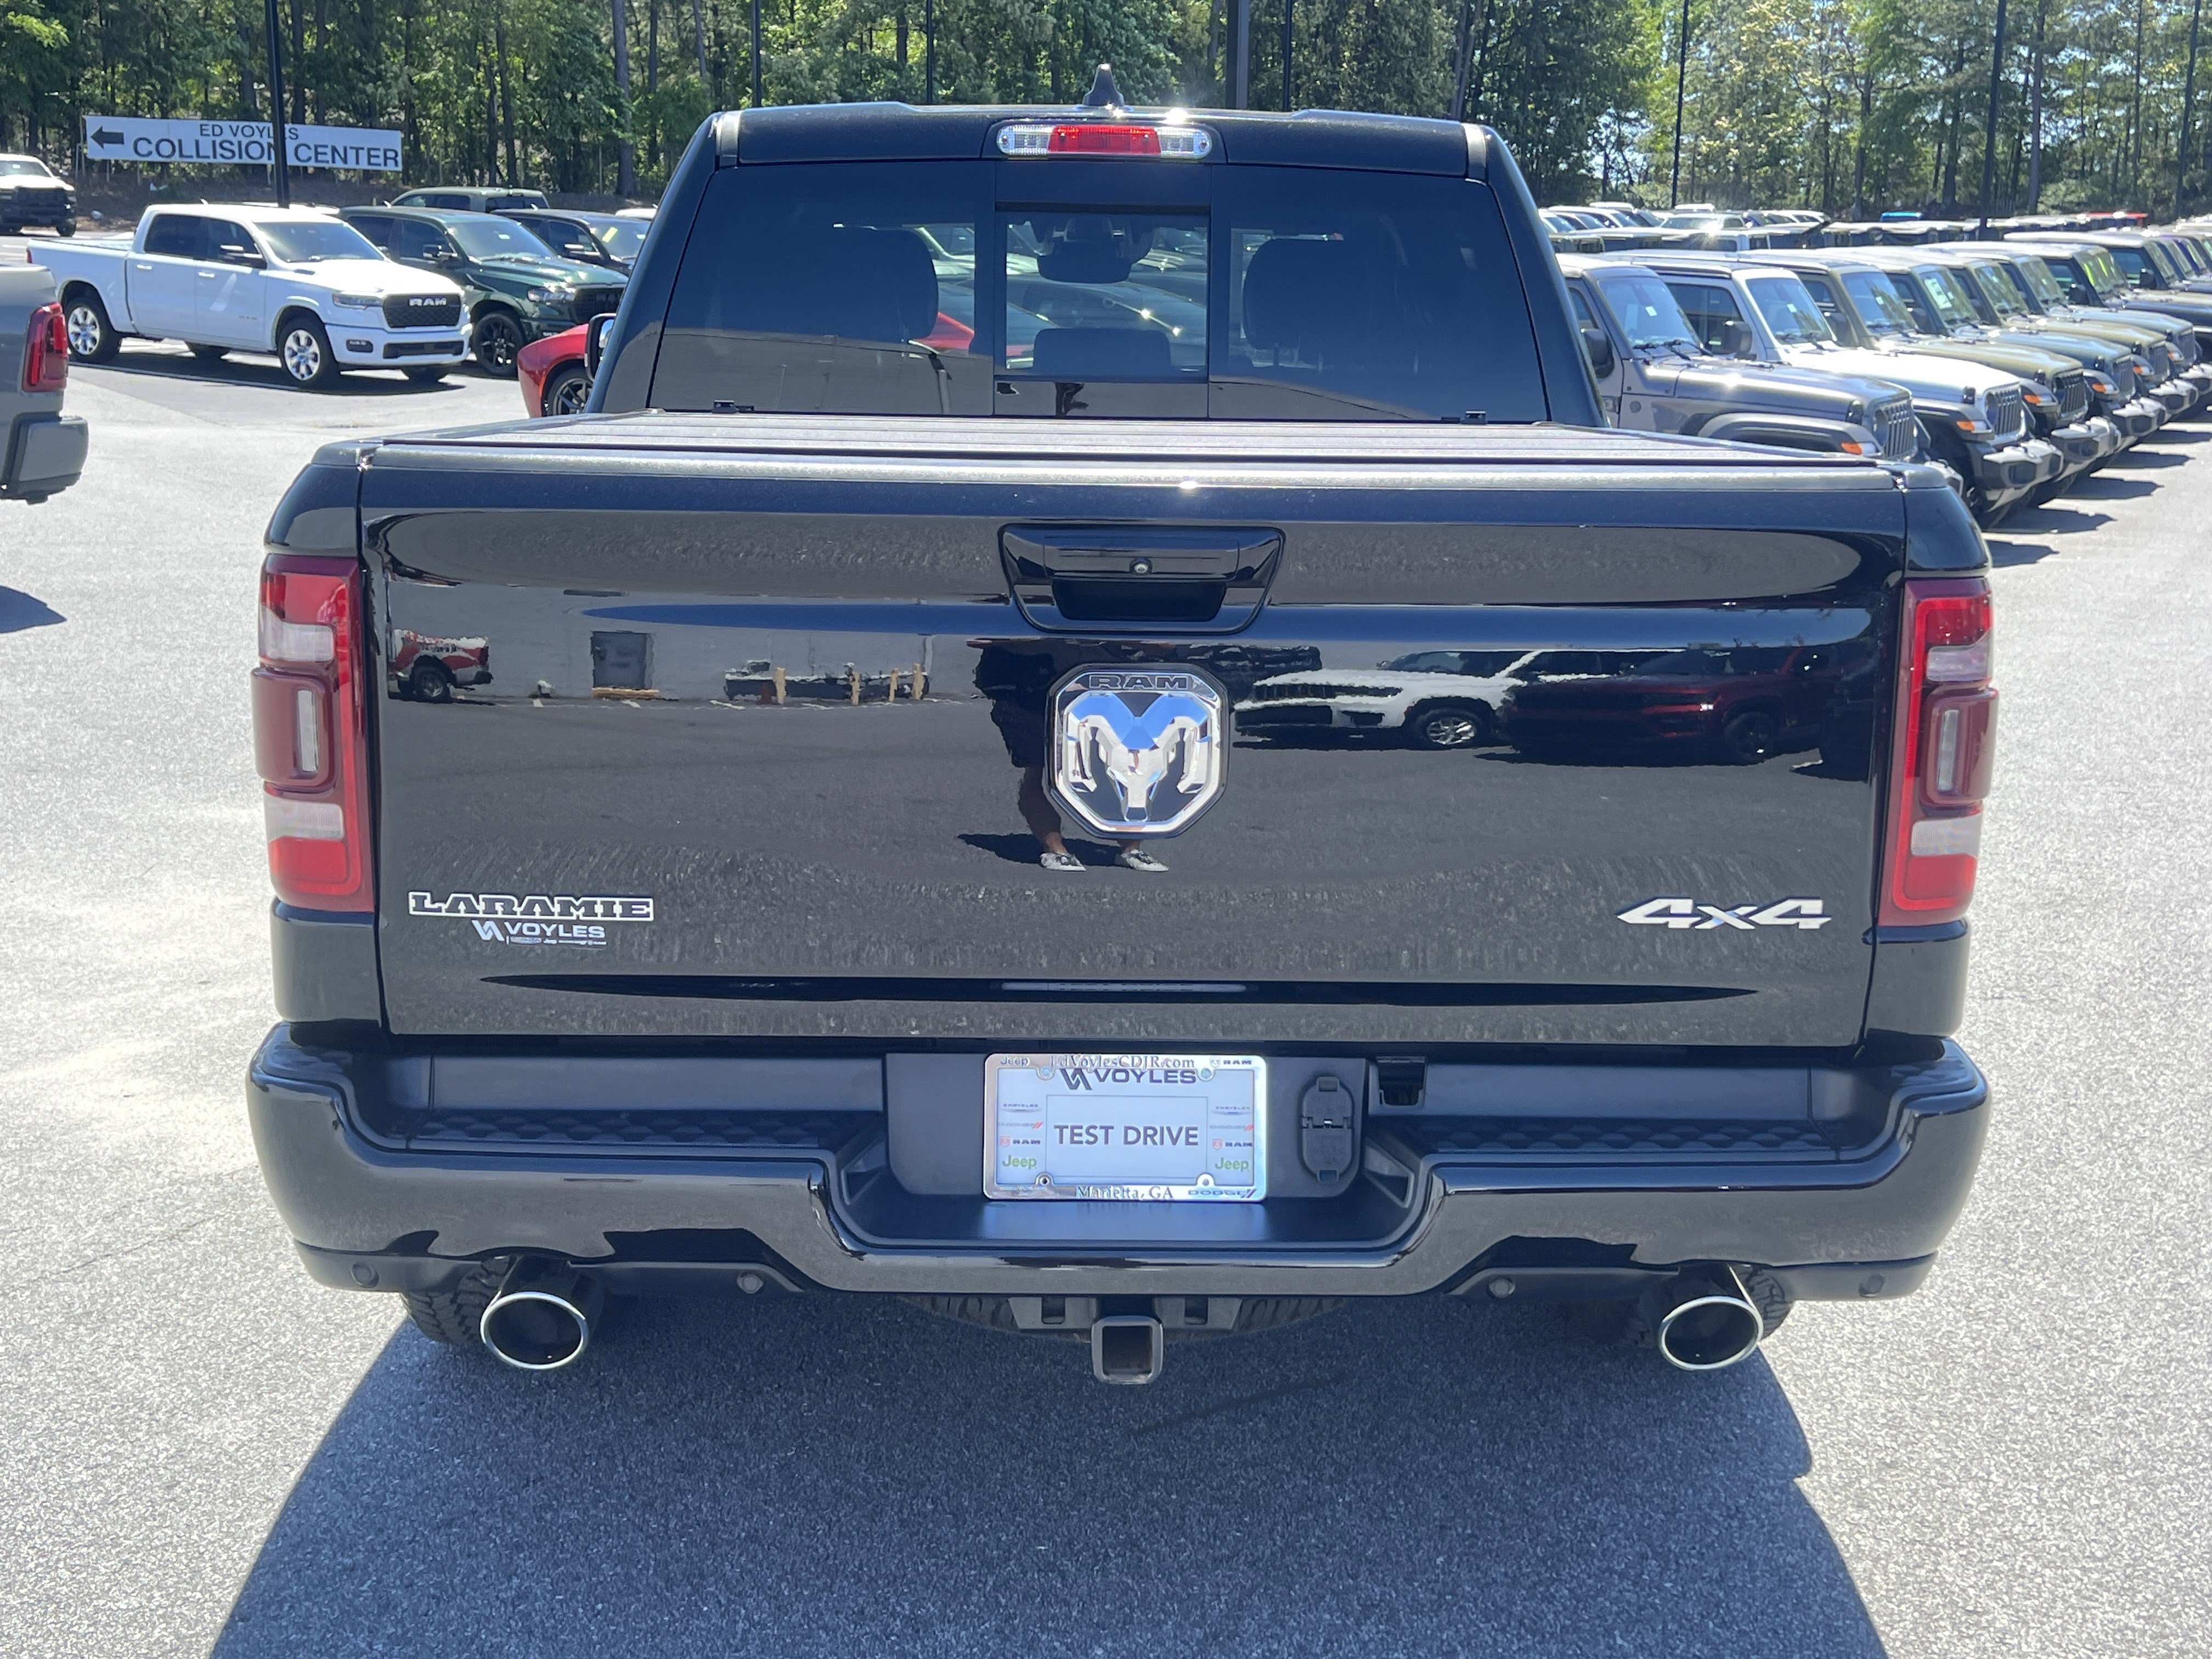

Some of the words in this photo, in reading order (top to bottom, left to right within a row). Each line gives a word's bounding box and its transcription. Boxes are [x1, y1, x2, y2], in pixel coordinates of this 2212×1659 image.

[200, 124, 223, 137] ED
[228, 125, 299, 140] VOYLS
[294, 143, 399, 167] CENTER
[409, 298, 447, 306] RAM
[1088, 674, 1189, 690] RAM
[408, 891, 654, 921] LARAMIE
[504, 921, 605, 938] VOYLES
[1000, 1056, 1029, 1068] Jeep
[1094, 1069, 1197, 1084] VOYLES
[1053, 1125, 1114, 1145] TEST
[1124, 1126, 1199, 1146] DRIVE
[1002, 1154, 1037, 1169] Jeep
[1215, 1157, 1249, 1172] Jeep
[1149, 1186, 1174, 1199] GA
